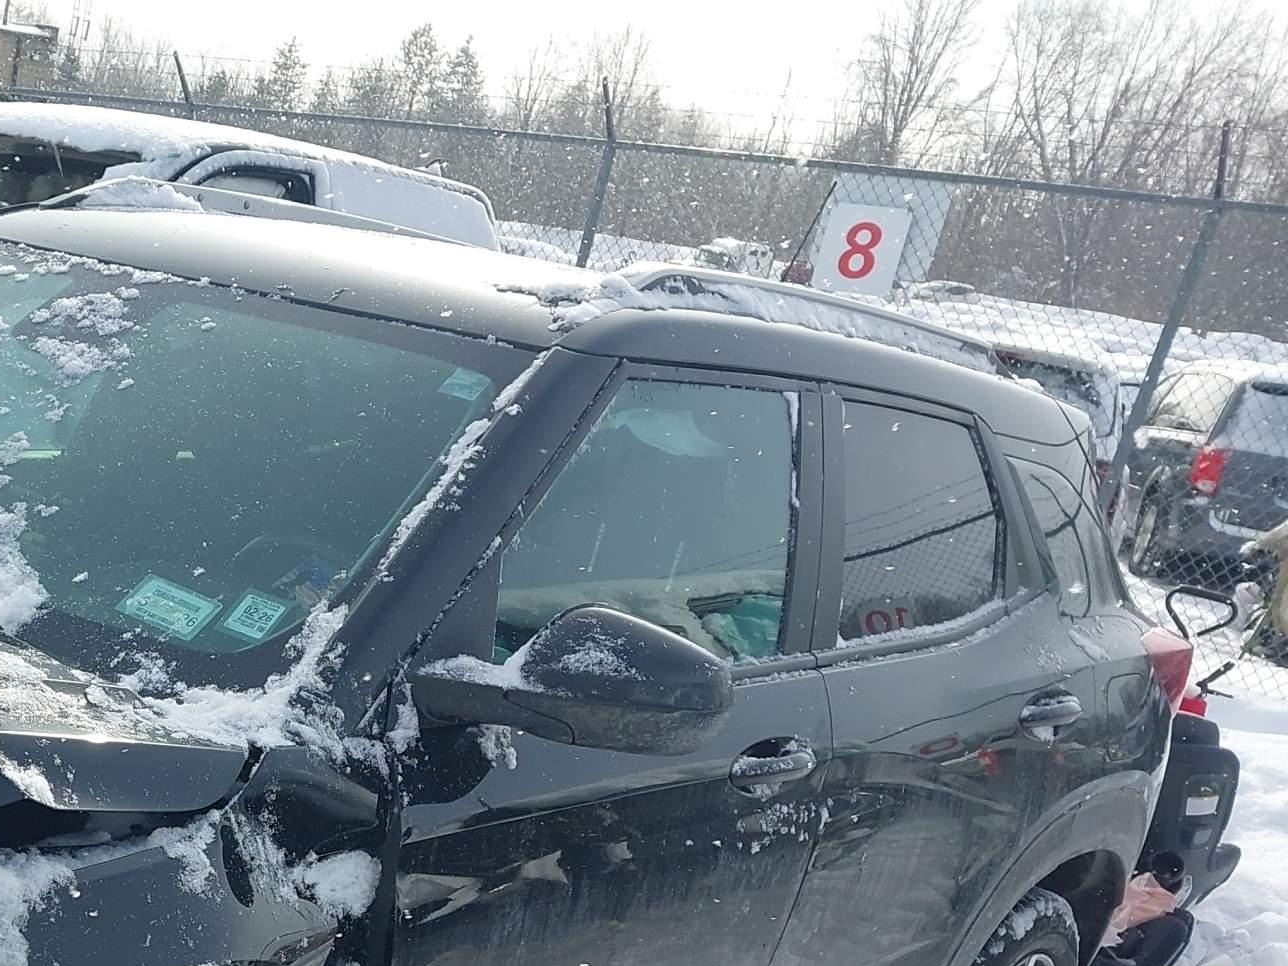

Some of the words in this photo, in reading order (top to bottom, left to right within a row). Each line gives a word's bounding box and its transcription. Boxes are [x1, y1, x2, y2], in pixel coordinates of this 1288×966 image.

[838, 221, 882, 279] 8
[243, 604, 258, 617] 02
[258, 611, 275, 623] 26
